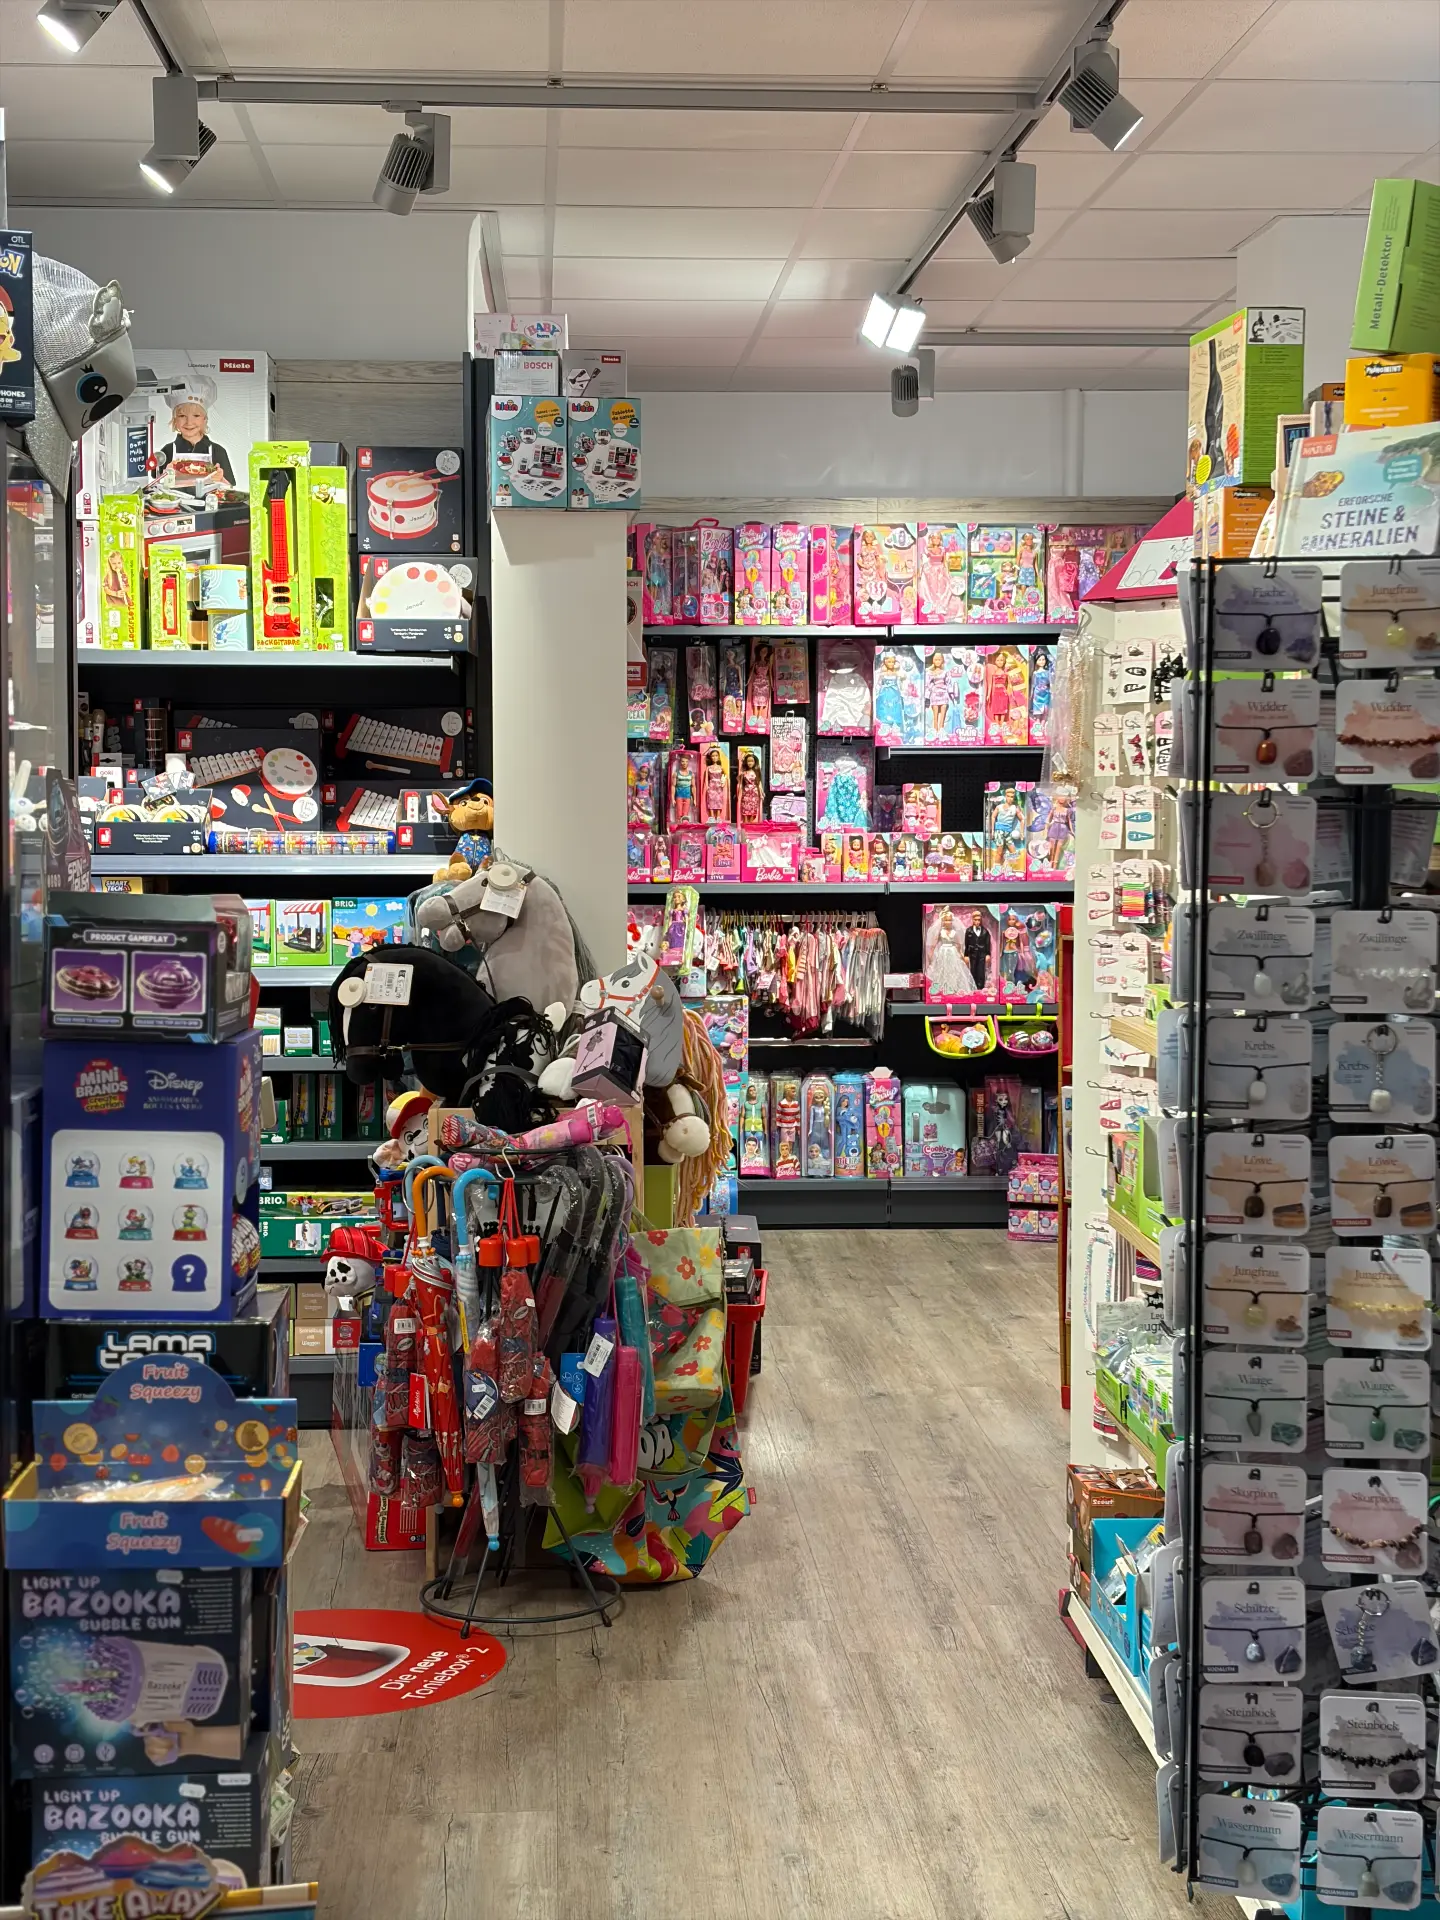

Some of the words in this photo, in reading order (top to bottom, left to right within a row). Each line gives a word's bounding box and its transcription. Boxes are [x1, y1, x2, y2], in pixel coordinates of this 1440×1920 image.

[11, 235, 26, 244] OTL
[1369, 234, 1393, 330] Metall-Detektor
[526, 321, 560, 336] BABY
[222, 361, 251, 370] Miele
[523, 361, 553, 370] BOSCH
[1338, 492, 1395, 507] ERFORSCHE
[1320, 507, 1390, 530] STEINE
[1393, 505, 1405, 523] &
[702, 528, 733, 551] Barbie
[1252, 586, 1287, 598] Fische
[1370, 583, 1420, 598] Jungfrau
[1247, 701, 1289, 712] Widder
[1370, 701, 1412, 713] Widder
[100, 769, 114, 777] goki
[674, 869, 696, 881] Barbie
[756, 868, 784, 882] Barbie
[335, 900, 357, 908] BRIO
[90, 932, 126, 943] PRODUCT
[127, 933, 169, 944] GAMEPLAY
[1237, 930, 1287, 941] Zwillinge
[1358, 932, 1408, 944] Zwillinge
[1244, 1040, 1276, 1051] Krebs
[1337, 1060, 1370, 1071] Krebs
[76, 1081, 128, 1098] BRANDS
[1243, 1154, 1273, 1166] Löwe
[1368, 1156, 1398, 1168] Löwe
[258, 1196, 285, 1205] BRIO
[1233, 1264, 1281, 1279] Jungfrau
[1354, 1268, 1401, 1282] Jungfrau
[142, 1362, 188, 1380] Fruit
[1238, 1373, 1273, 1386] Waage
[1358, 1379, 1396, 1392] Waage
[130, 1384, 202, 1403] Squeezy
[1230, 1486, 1279, 1500] Skorpion
[1351, 1491, 1400, 1504] Skorpion
[119, 1511, 168, 1530] Fruit
[106, 1533, 182, 1555] Squeezy
[22, 1576, 74, 1590] LIGHT
[78, 1575, 101, 1589] UP
[22, 1588, 181, 1618] BAZOOKA
[1234, 1603, 1276, 1614] Schütze
[79, 1617, 141, 1632] BUBBLE
[146, 1616, 181, 1630] GUN
[1335, 1622, 1375, 1637] Schze
[466, 1646, 490, 1655] 2
[379, 1670, 417, 1691] Die
[409, 1649, 449, 1675] neue
[1224, 1707, 1277, 1718] Steinbock
[1346, 1719, 1400, 1732] Steinbock
[44, 1790, 95, 1804] LIGHT
[98, 1789, 121, 1803] UP
[43, 1802, 200, 1831] BAZOOKA
[1214, 1816, 1282, 1836] Wassermann
[100, 1830, 161, 1844] BULE
[167, 1830, 201, 1844] GUN
[1337, 1828, 1404, 1844] Wassermann
[1201, 1875, 1236, 1887] AQUAMARIN
[1320, 1888, 1355, 1898] AQUAMARIN
[125, 1888, 219, 1919] AWAY
